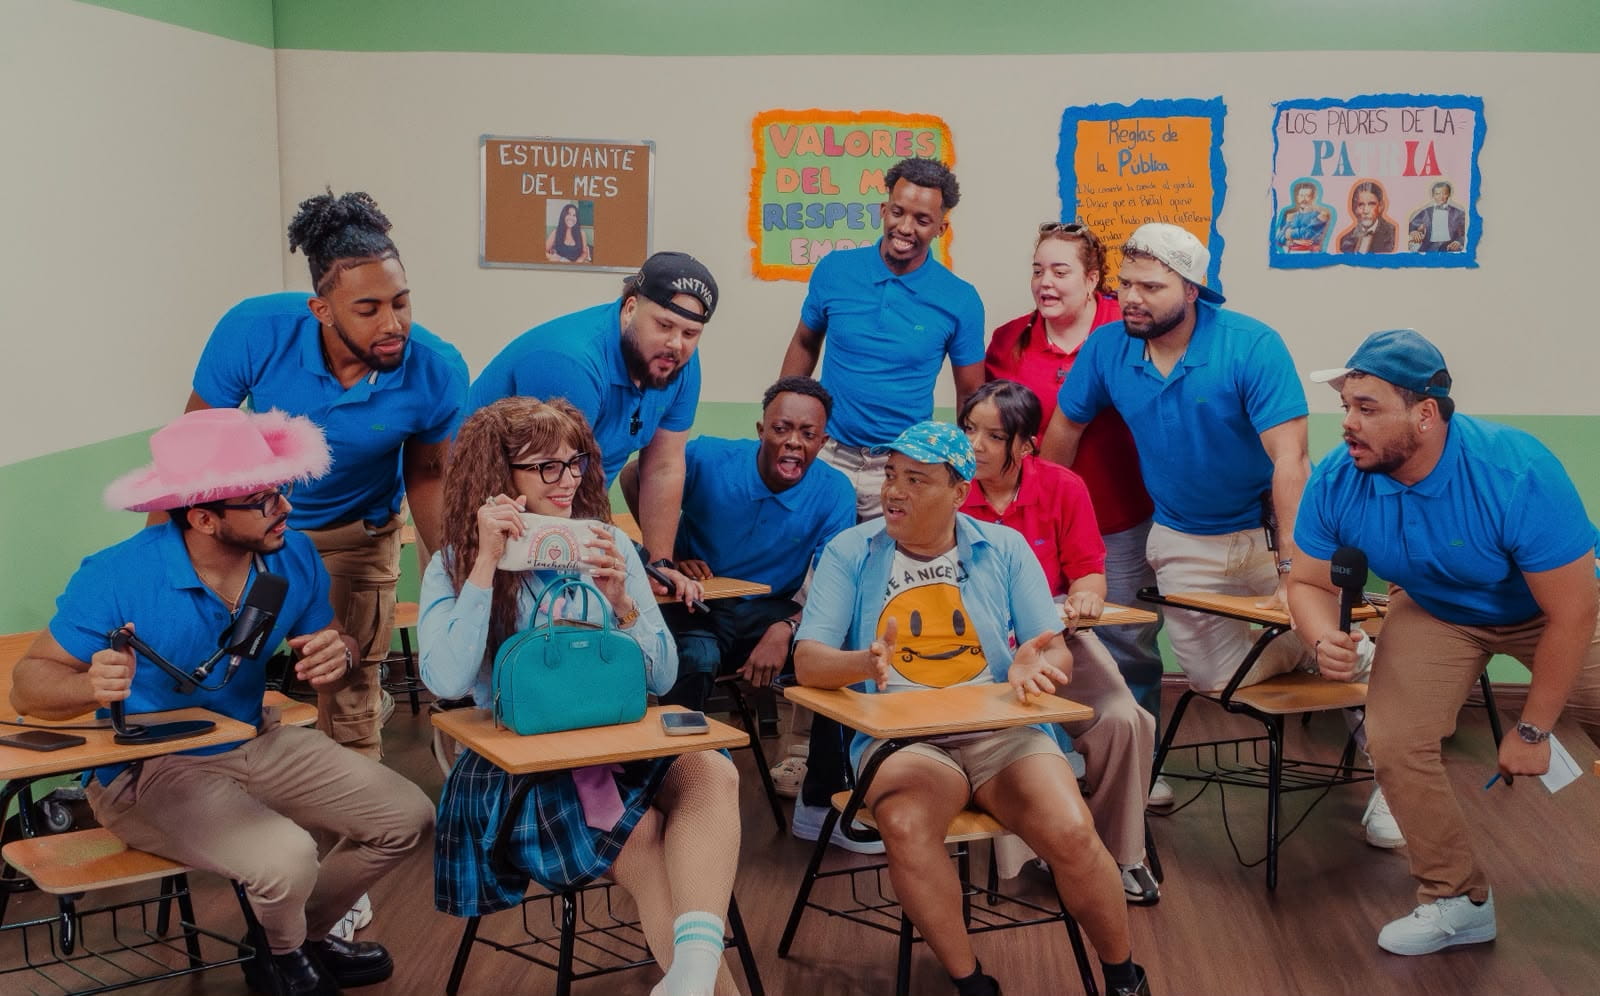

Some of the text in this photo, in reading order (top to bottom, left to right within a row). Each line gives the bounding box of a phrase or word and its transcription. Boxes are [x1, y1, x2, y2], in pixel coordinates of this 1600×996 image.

[1108, 120, 1179, 149] Reglas de
[1286, 108, 1455, 136] LOS PADRES DE LA
[768, 124, 937, 158] VALORES
[500, 144, 636, 171] ESTUDIANTE
[1096, 152, 1108, 173] la
[1310, 140, 1443, 177] PATRIA
[521, 173, 619, 198] DEL MES
[776, 166, 889, 195] DEL M
[763, 202, 884, 231] RESPET
[903, 570, 915, 584] A
[917, 565, 953, 581] NICE
